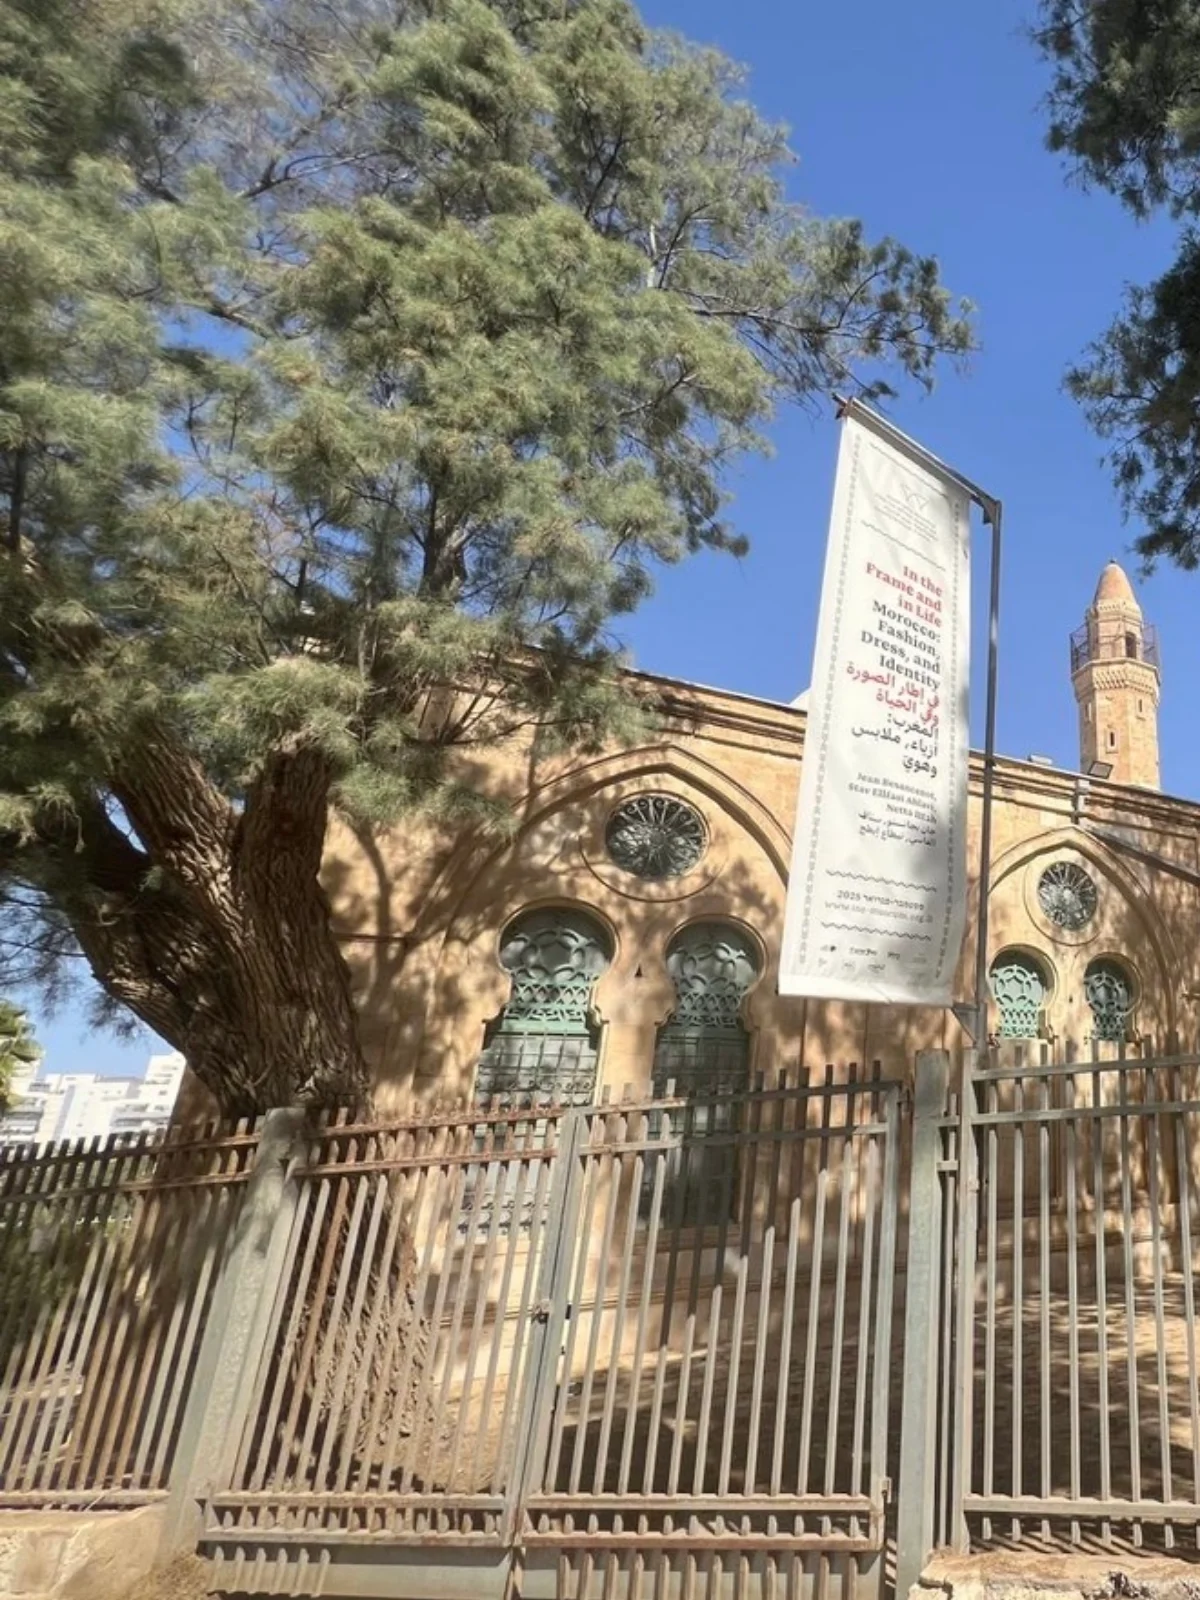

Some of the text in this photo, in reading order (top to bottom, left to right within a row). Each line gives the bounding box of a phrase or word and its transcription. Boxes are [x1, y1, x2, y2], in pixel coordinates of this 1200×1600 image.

[866, 562, 941, 613] Frame and
[903, 566, 943, 597] In the
[872, 600, 941, 644] Morocco:
[898, 594, 942, 628] in Life
[861, 630, 940, 675] Dress, and
[878, 619, 941, 661] Fashion,
[846, 660, 896, 688] الصورة
[880, 655, 941, 692] Identity
[876, 688, 917, 714] الحياة
[852, 727, 901, 744] ملابس
